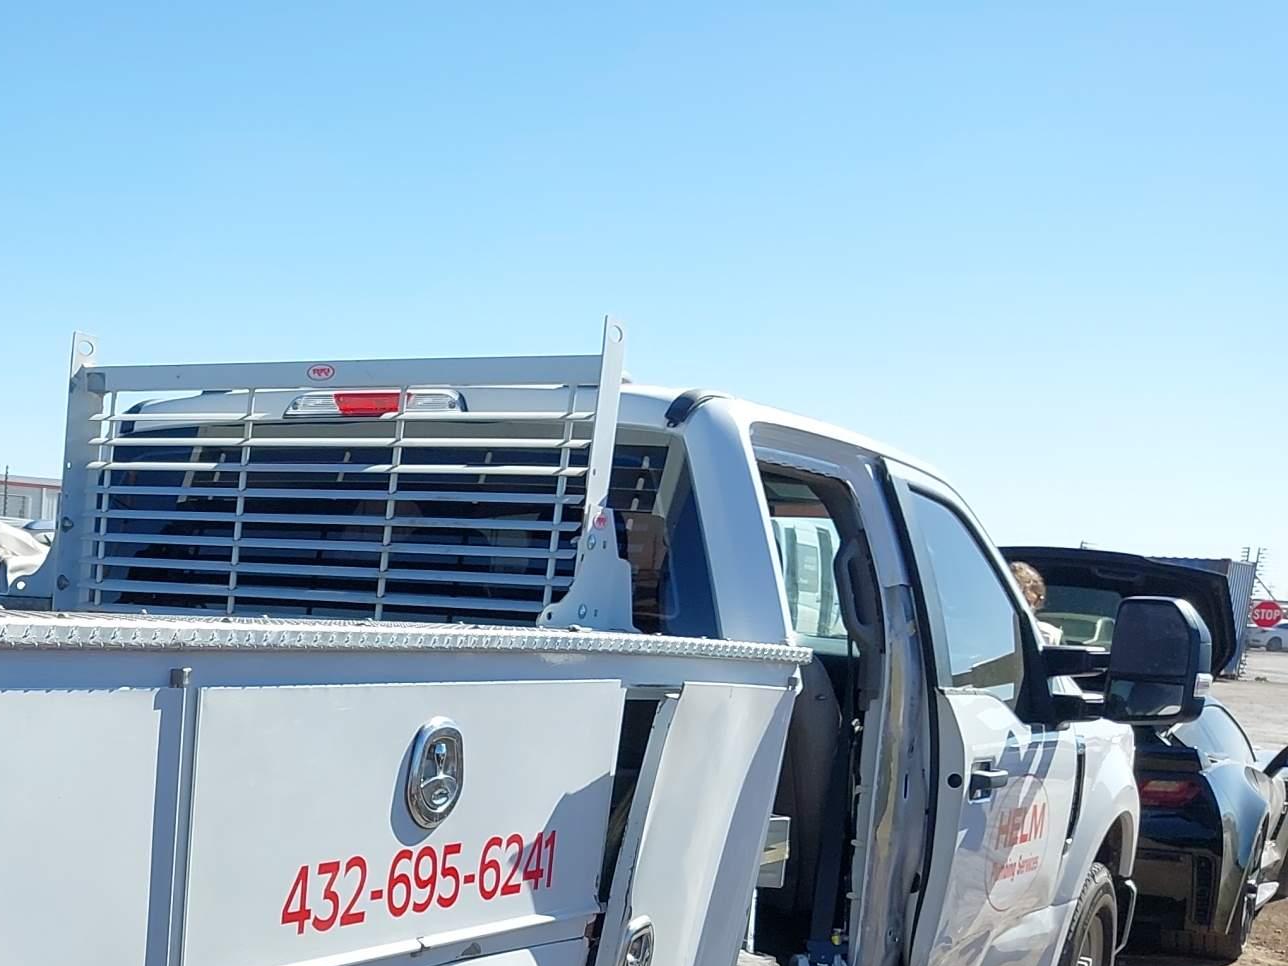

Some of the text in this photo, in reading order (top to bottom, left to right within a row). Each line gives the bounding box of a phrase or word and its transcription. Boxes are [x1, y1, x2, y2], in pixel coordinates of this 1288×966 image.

[1252, 608, 1281, 621] STOP
[994, 802, 1046, 851] HELM
[281, 830, 556, 935] 432-695-6241
